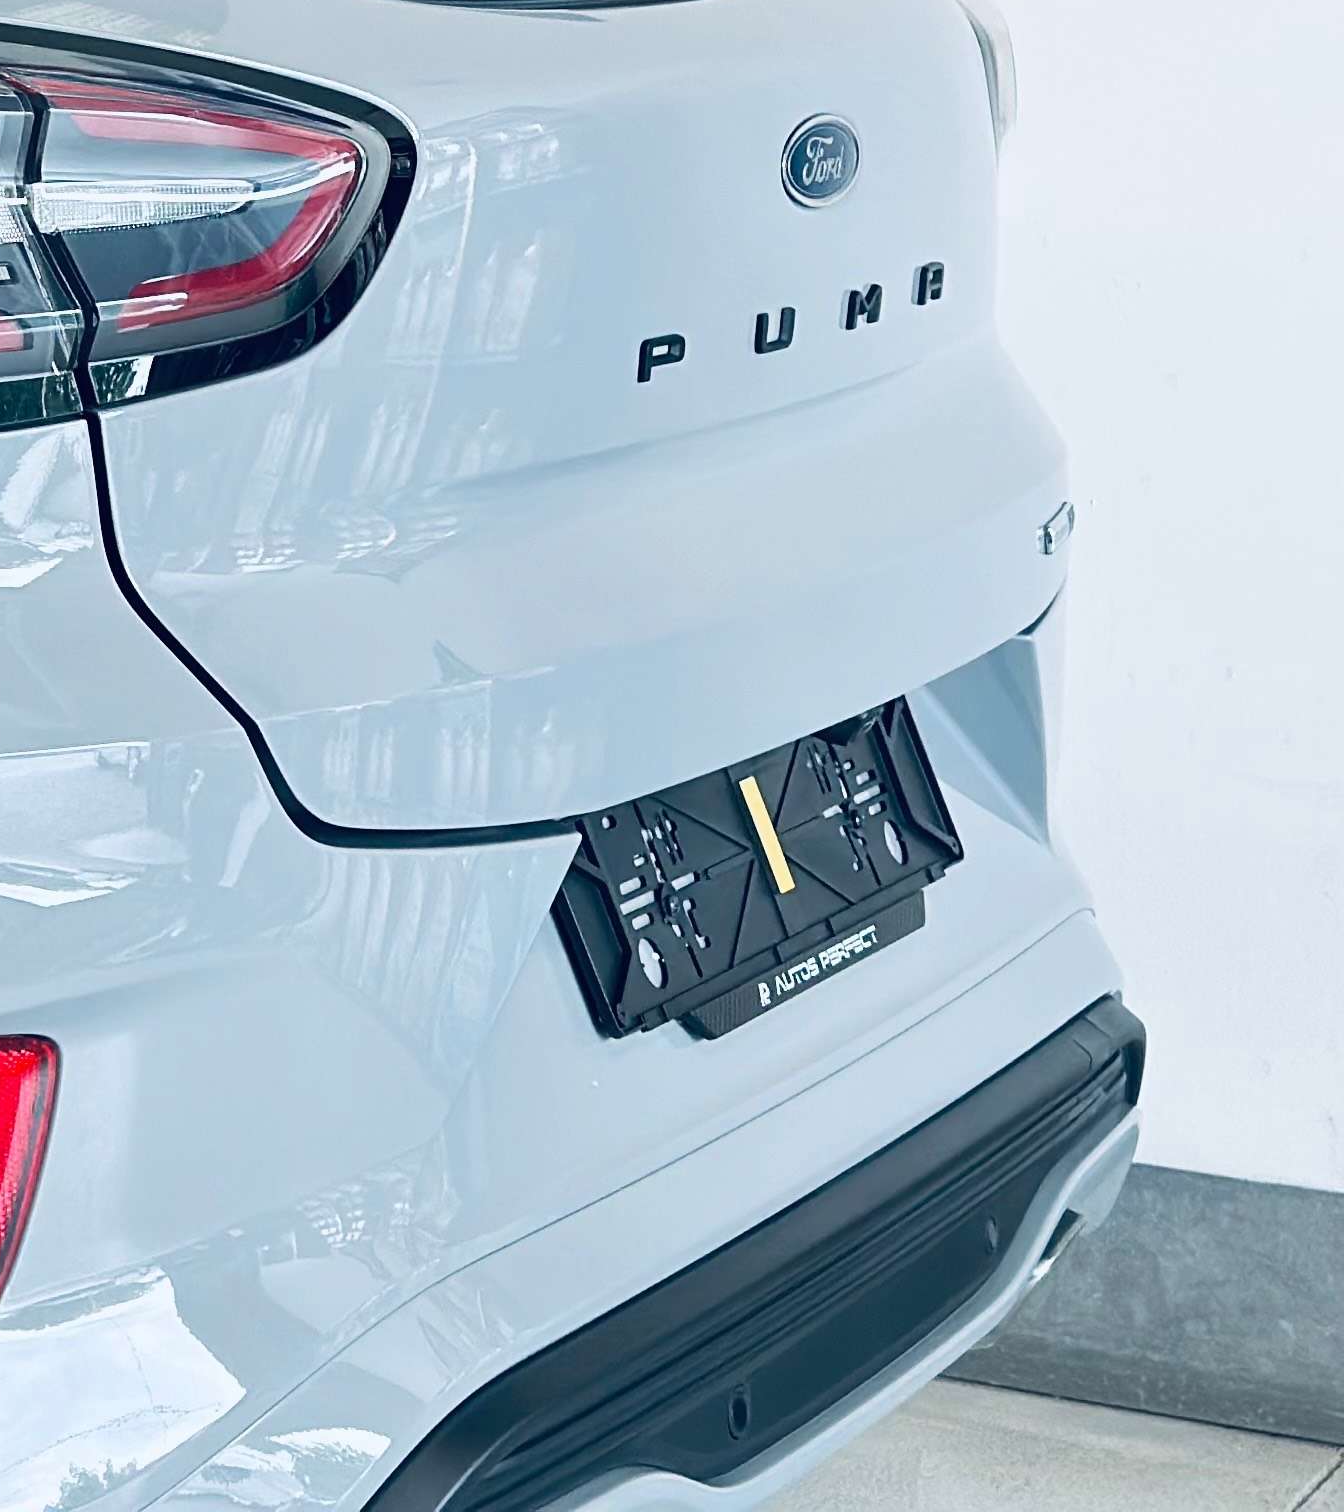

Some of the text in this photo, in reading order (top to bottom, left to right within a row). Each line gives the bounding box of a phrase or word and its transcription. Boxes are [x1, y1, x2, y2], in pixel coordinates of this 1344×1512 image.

[802, 135, 844, 186] Ford
[637, 261, 945, 384] PUMA
[774, 956, 820, 996] AUTOS
[818, 924, 878, 969] PERFECT
